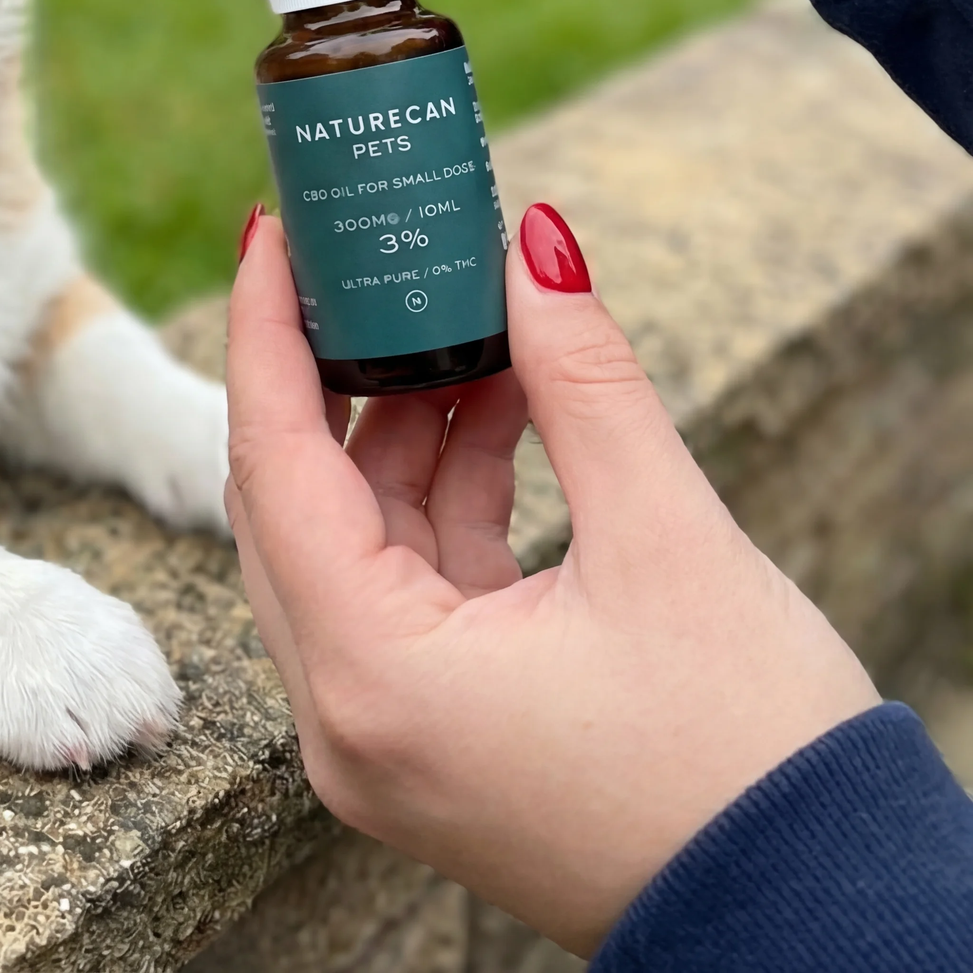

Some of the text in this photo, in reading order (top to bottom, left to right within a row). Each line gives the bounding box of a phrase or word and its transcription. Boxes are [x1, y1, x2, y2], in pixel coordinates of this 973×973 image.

[296, 97, 456, 143] NATURECAN
[353, 136, 412, 159] PETS
[331, 186, 355, 199] OIL
[358, 180, 389, 195] FOR
[393, 170, 442, 189] SMALL
[379, 228, 429, 254] 3%
[342, 276, 381, 290] ULTRA
[384, 269, 420, 284] PURE
[432, 264, 453, 276] 0%
[455, 256, 477, 270] THC
